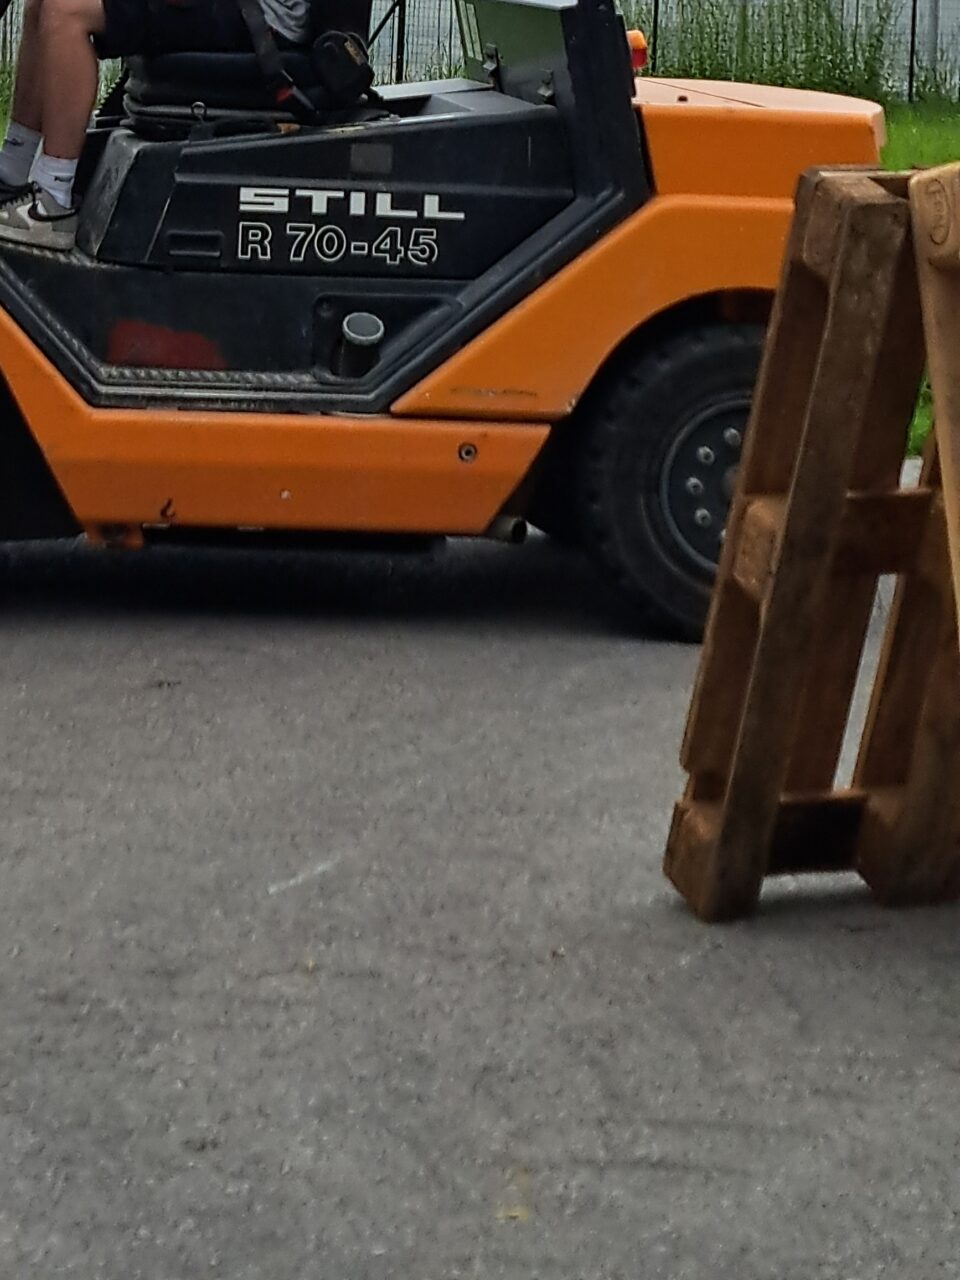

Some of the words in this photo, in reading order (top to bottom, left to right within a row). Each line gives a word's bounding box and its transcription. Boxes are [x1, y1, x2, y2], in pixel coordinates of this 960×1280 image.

[239, 186, 466, 220] STILL
[238, 221, 272, 259] R
[286, 222, 439, 265] 70-45
